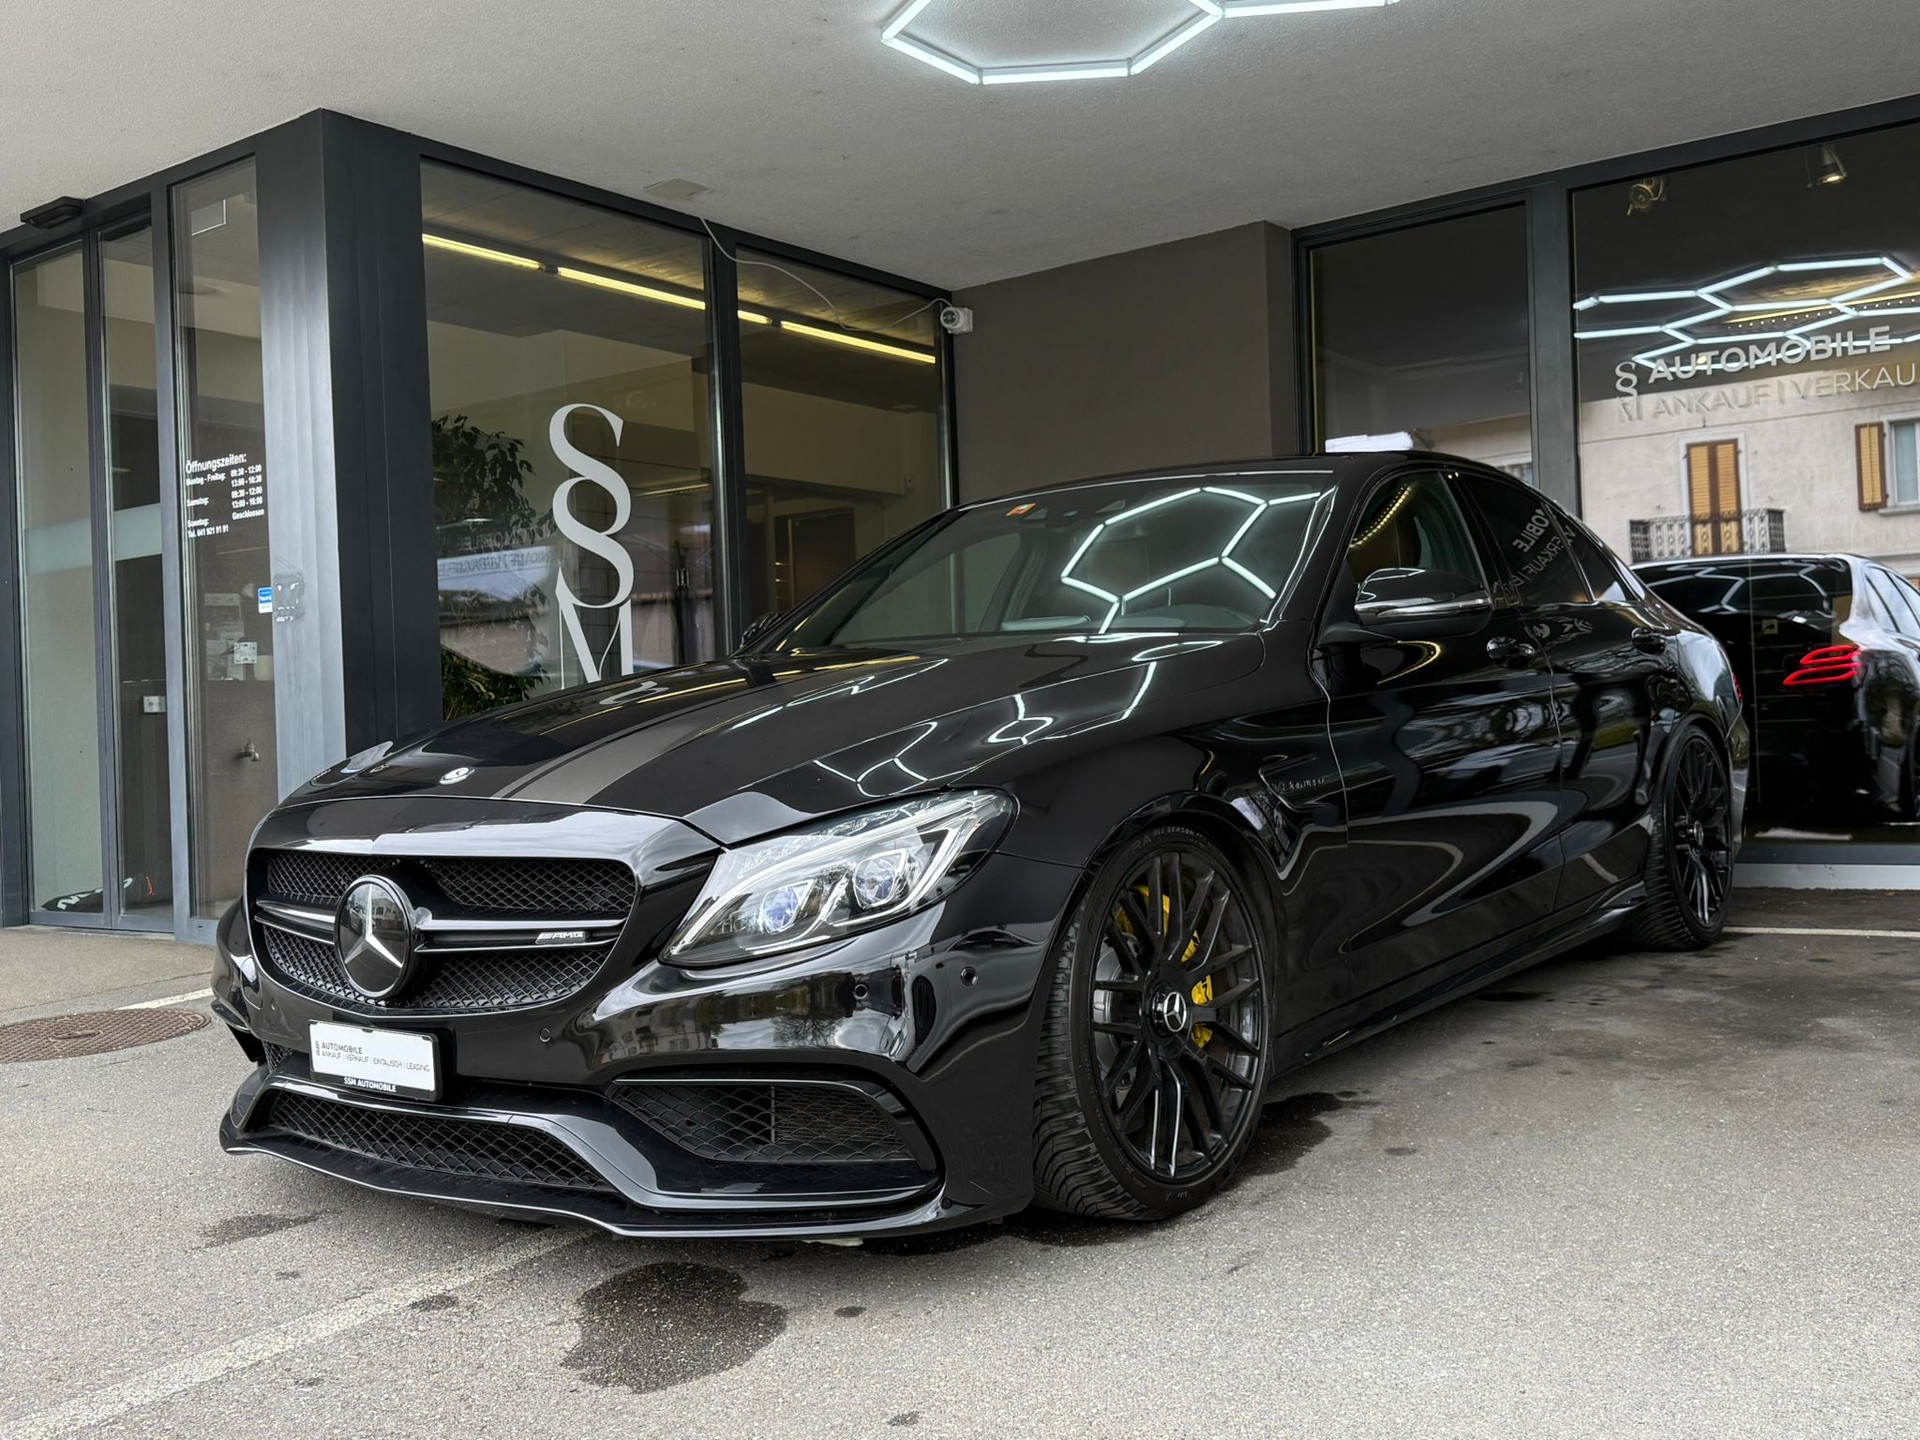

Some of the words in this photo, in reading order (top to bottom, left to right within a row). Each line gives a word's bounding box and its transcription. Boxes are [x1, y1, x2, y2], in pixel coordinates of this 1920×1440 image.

[1648, 325, 1891, 384] AUTOMOBILE
[186, 453, 247, 474] Öffnungszeiten:
[1167, 826, 1194, 836] SEASON
[321, 1042, 362, 1055] AUTOMOBILE
[407, 1062, 430, 1072] LEASING
[344, 1076, 356, 1086] SSM
[358, 1078, 397, 1093] AUTOMOBILE
